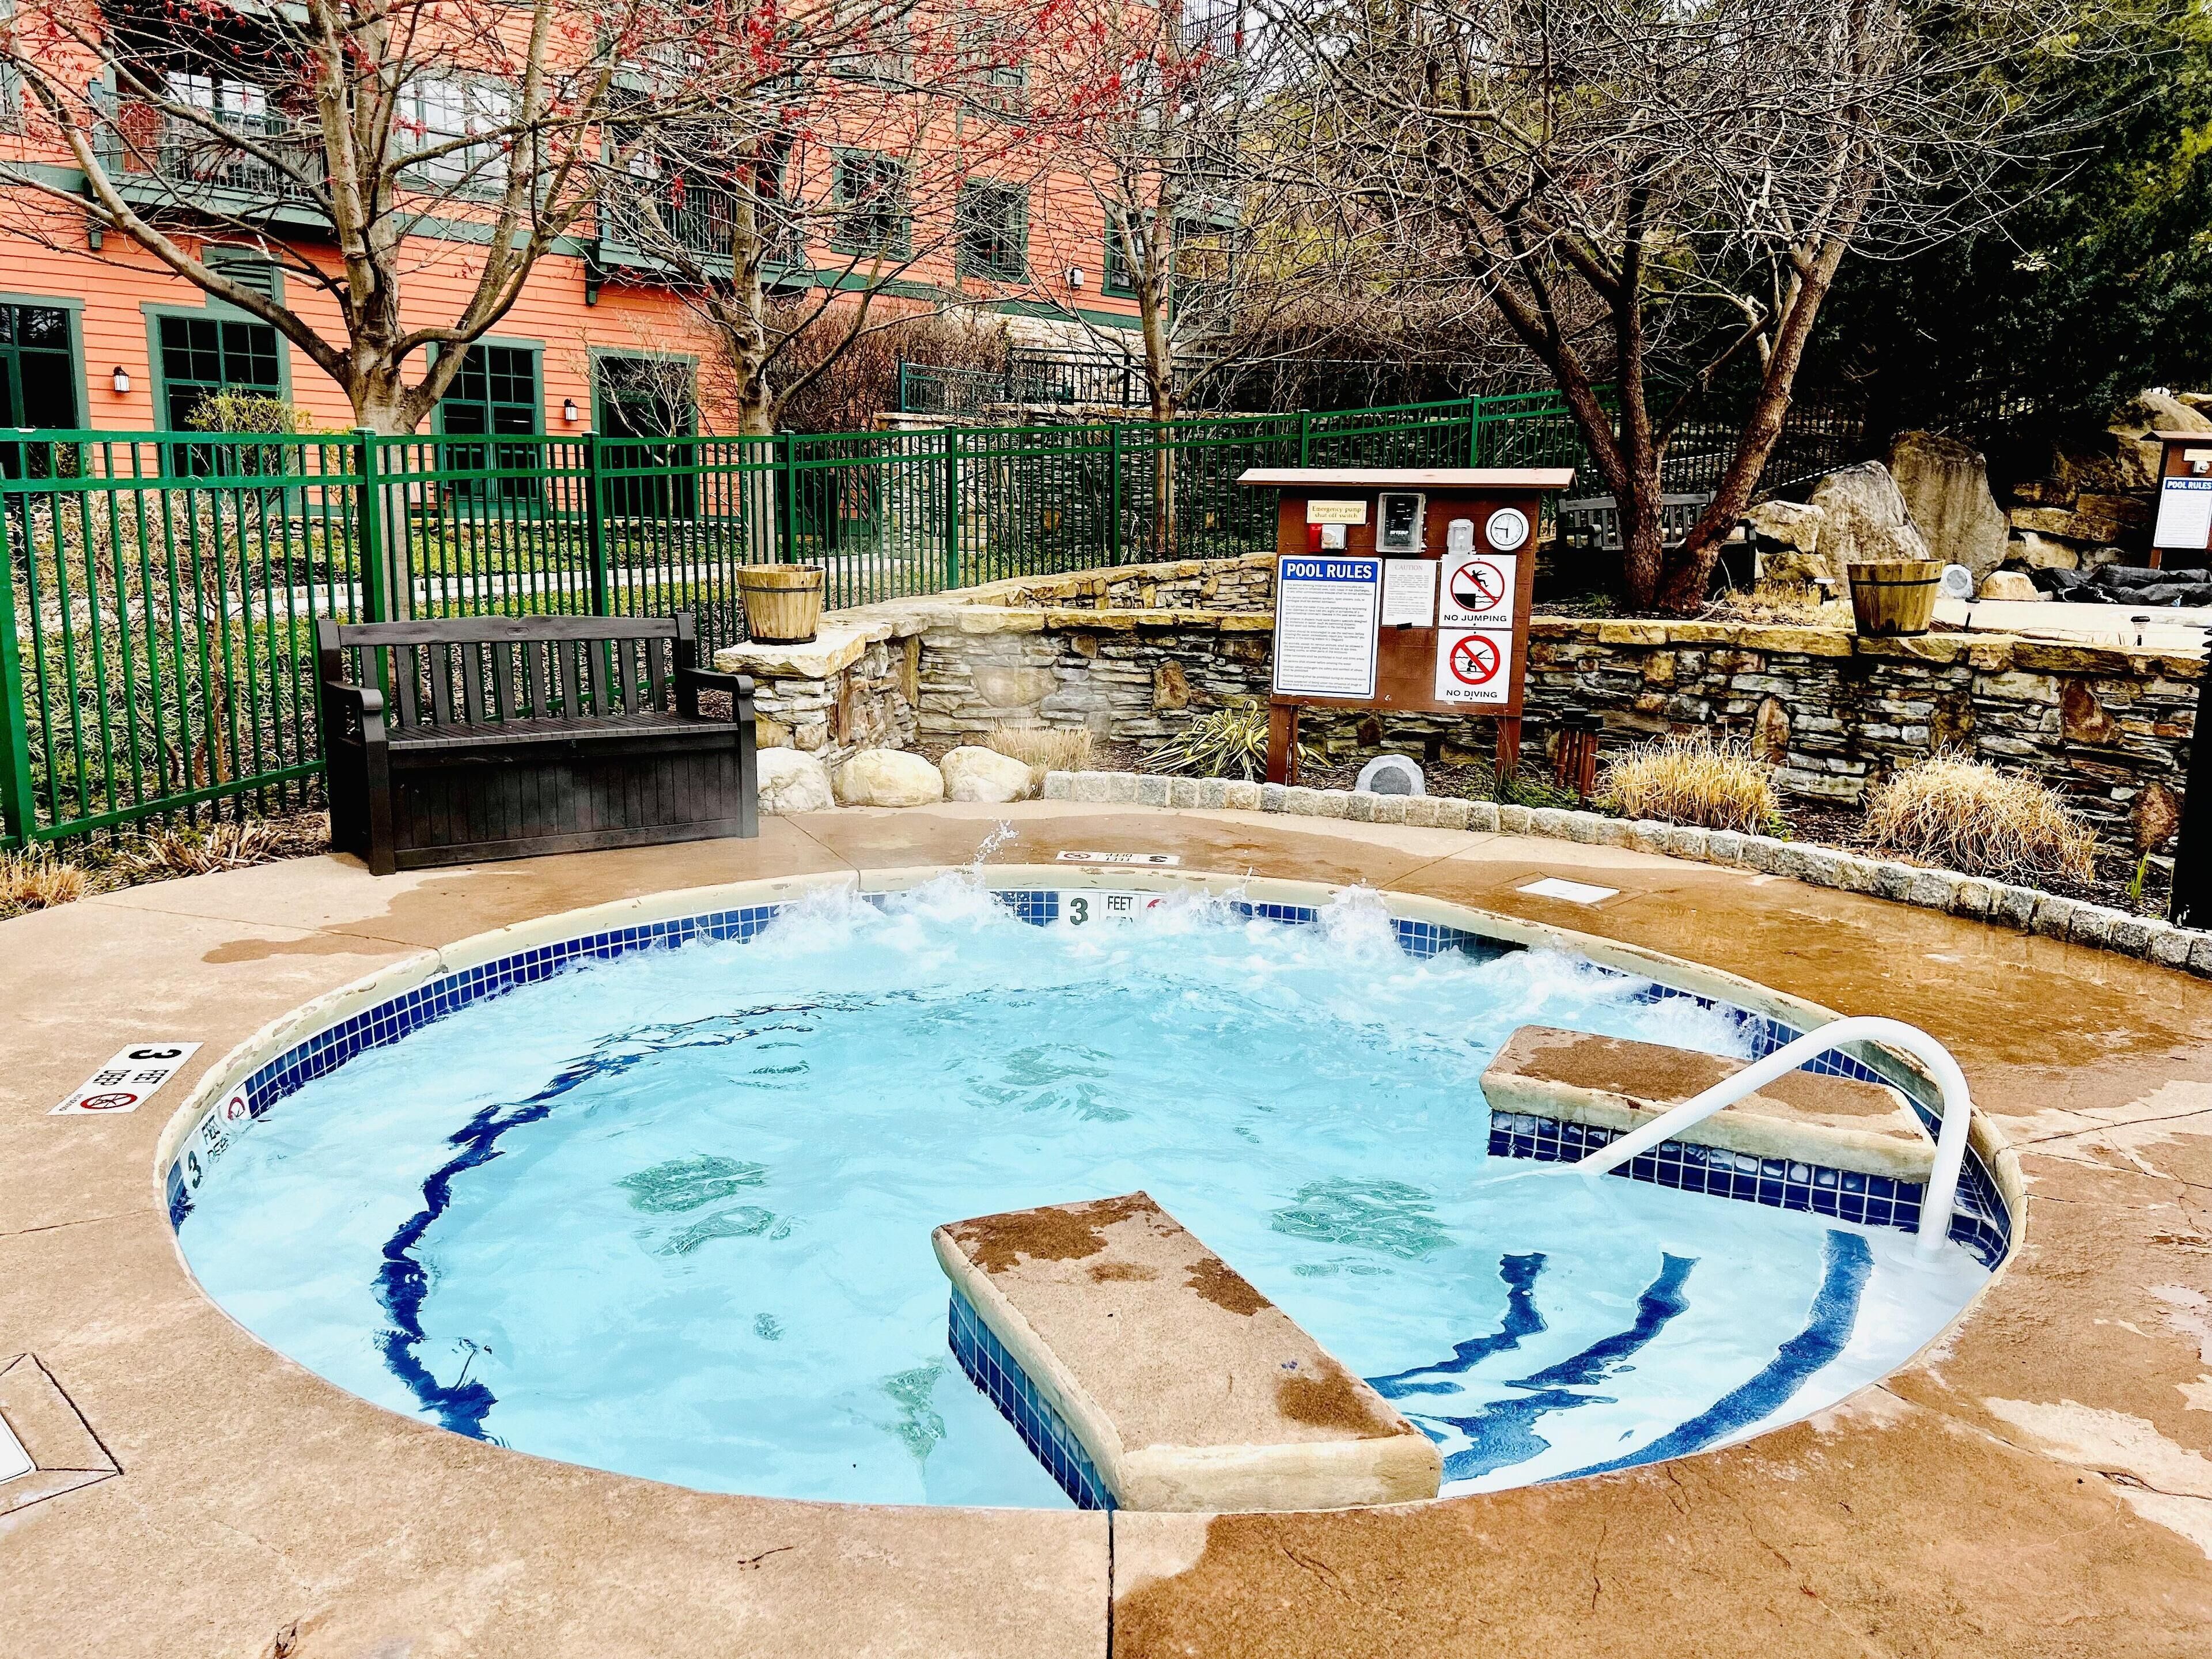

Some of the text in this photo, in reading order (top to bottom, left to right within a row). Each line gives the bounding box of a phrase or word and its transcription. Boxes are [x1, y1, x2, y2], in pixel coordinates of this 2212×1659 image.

[2188, 482, 2211, 490] RULES
[1287, 563, 1372, 579] POOL RULES
[1108, 895, 1132, 910] FEET
[1070, 897, 1089, 925] 3
[128, 1049, 182, 1059] 3
[92, 1070, 131, 1085] DEEP
[131, 1070, 169, 1084] FEET
[202, 1114, 220, 1145] FEET
[188, 1150, 203, 1188] 3
